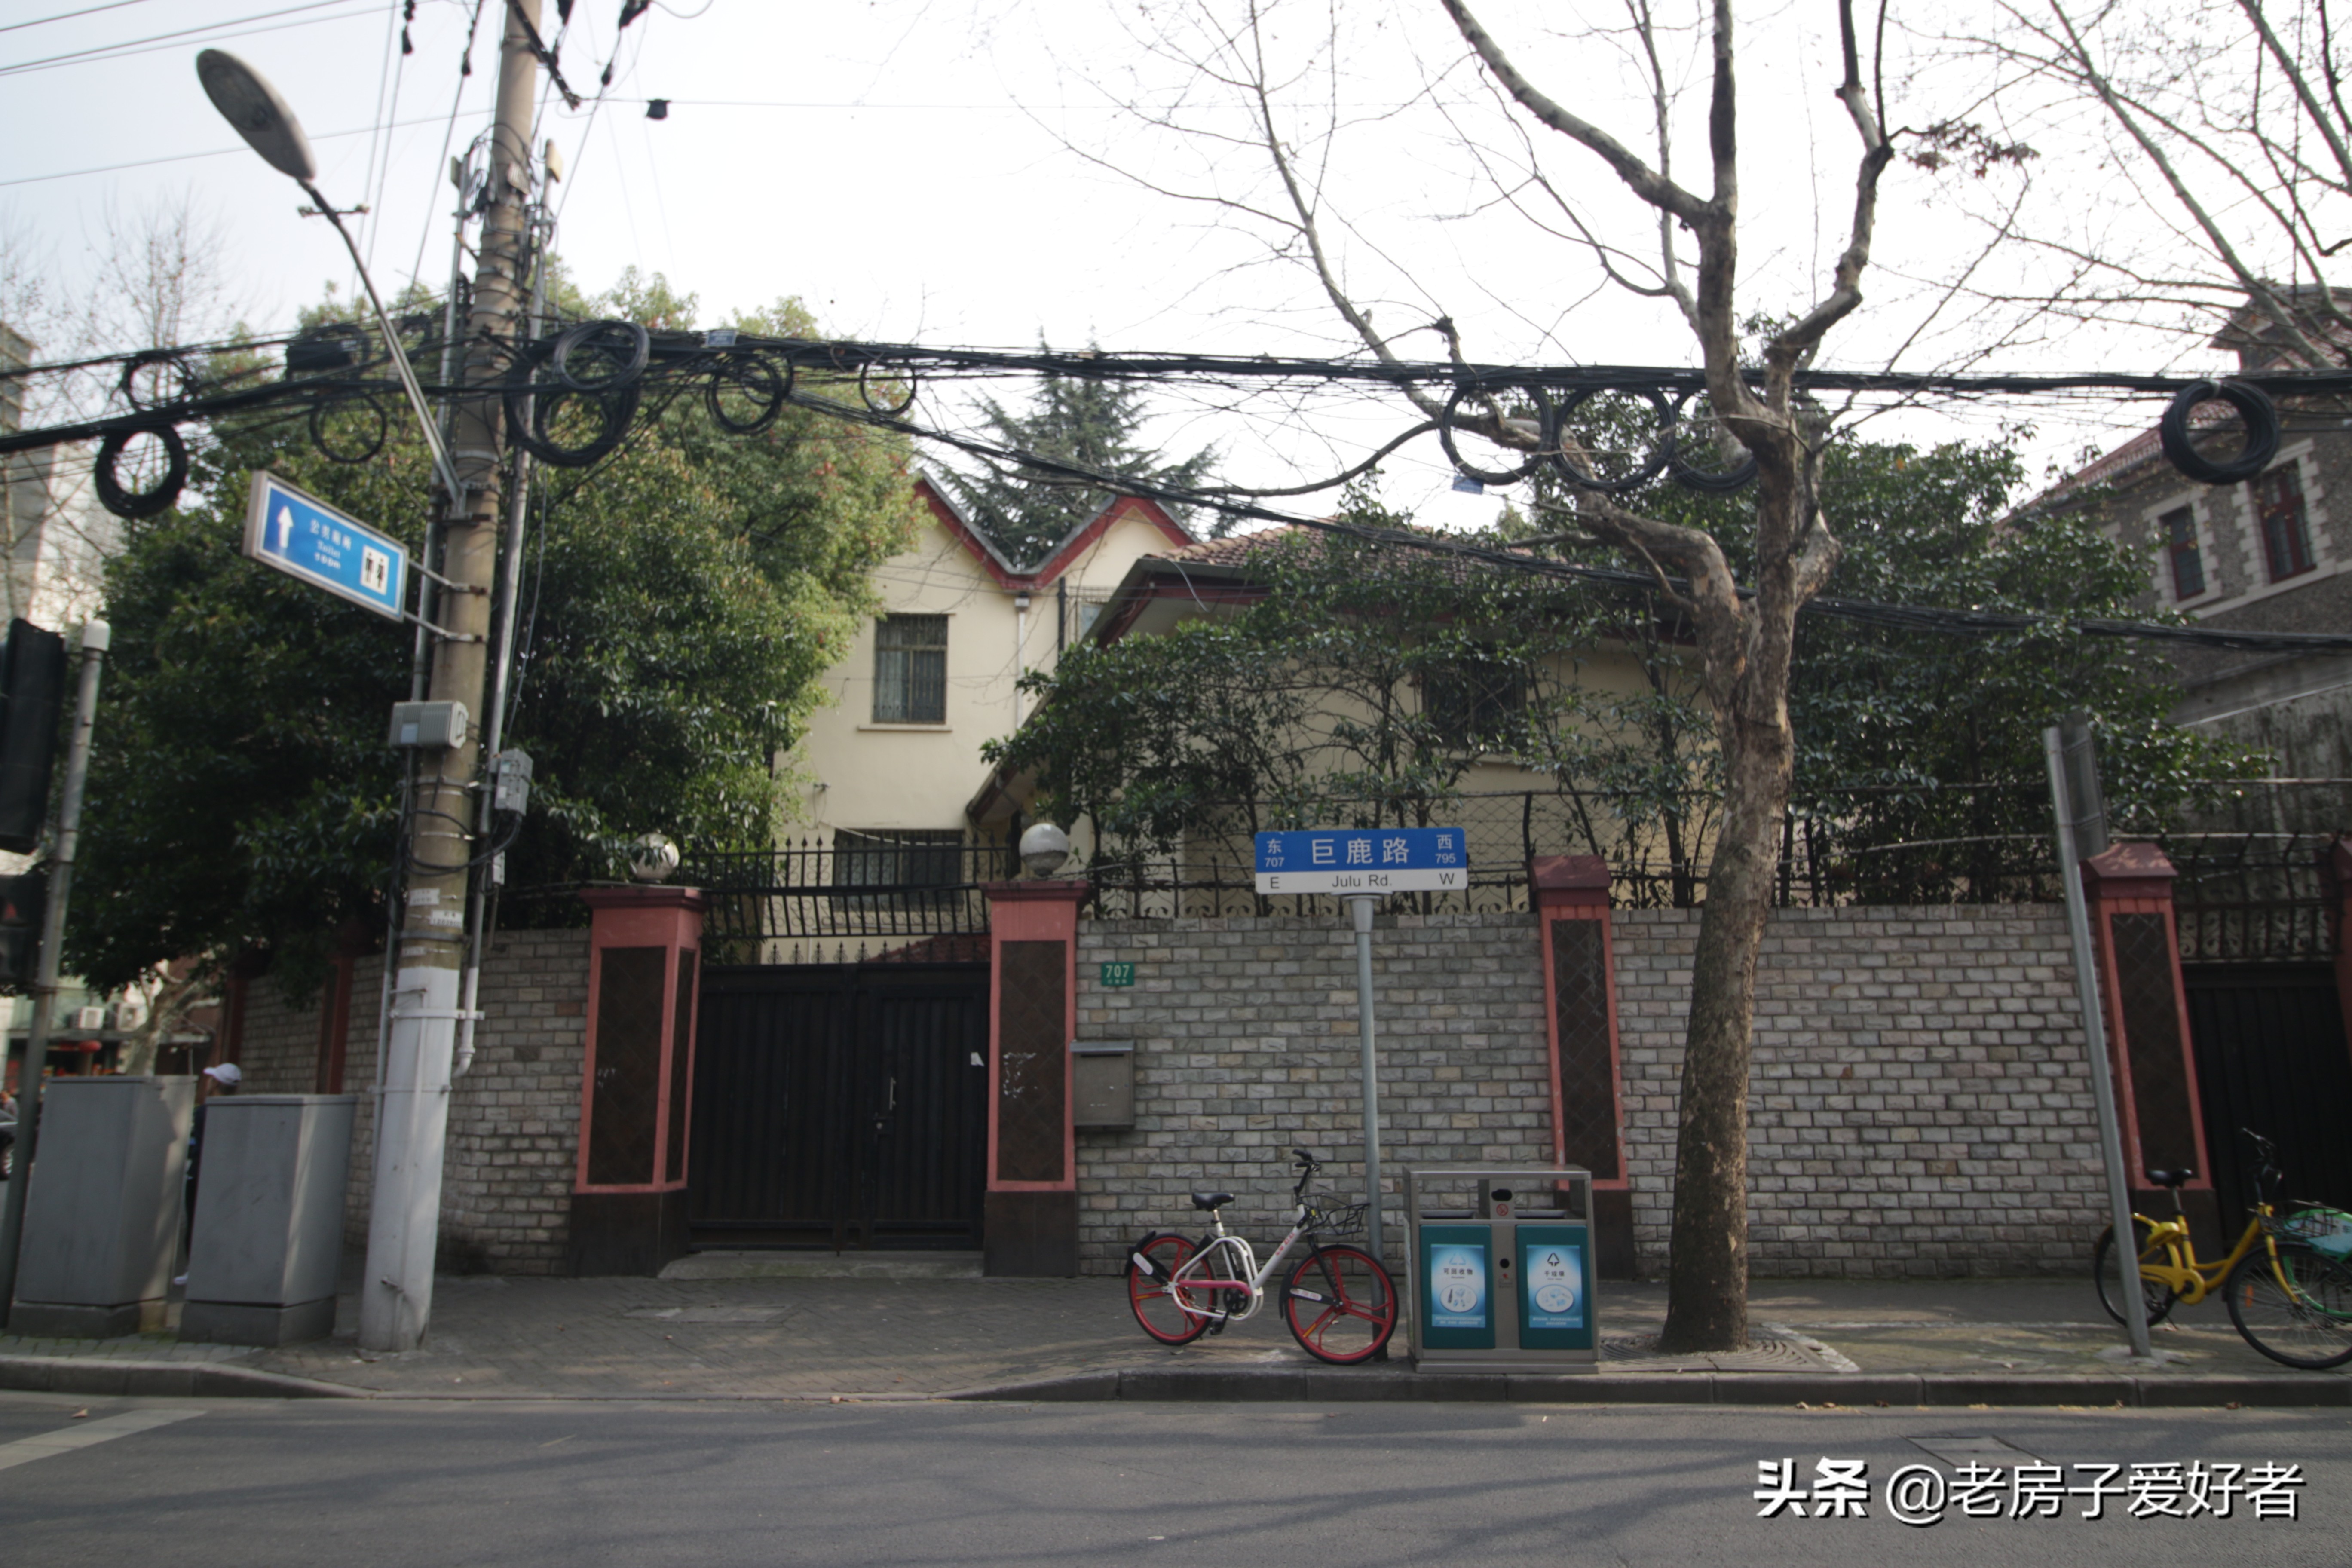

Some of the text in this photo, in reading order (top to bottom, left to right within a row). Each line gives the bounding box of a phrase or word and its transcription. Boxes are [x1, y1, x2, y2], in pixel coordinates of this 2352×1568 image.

[315, 551, 341, 569] 100m
[1266, 839, 1283, 854] 东
[1436, 834, 1453, 851] 西
[1311, 837, 1410, 865] 巨鹿路
[1265, 857, 1285, 868] 707
[1435, 853, 1456, 864] 795
[1270, 876, 1280, 889] E
[1332, 874, 1392, 887] Julu Rd.
[1439, 873, 1455, 885] W
[1106, 965, 1130, 978] 707
